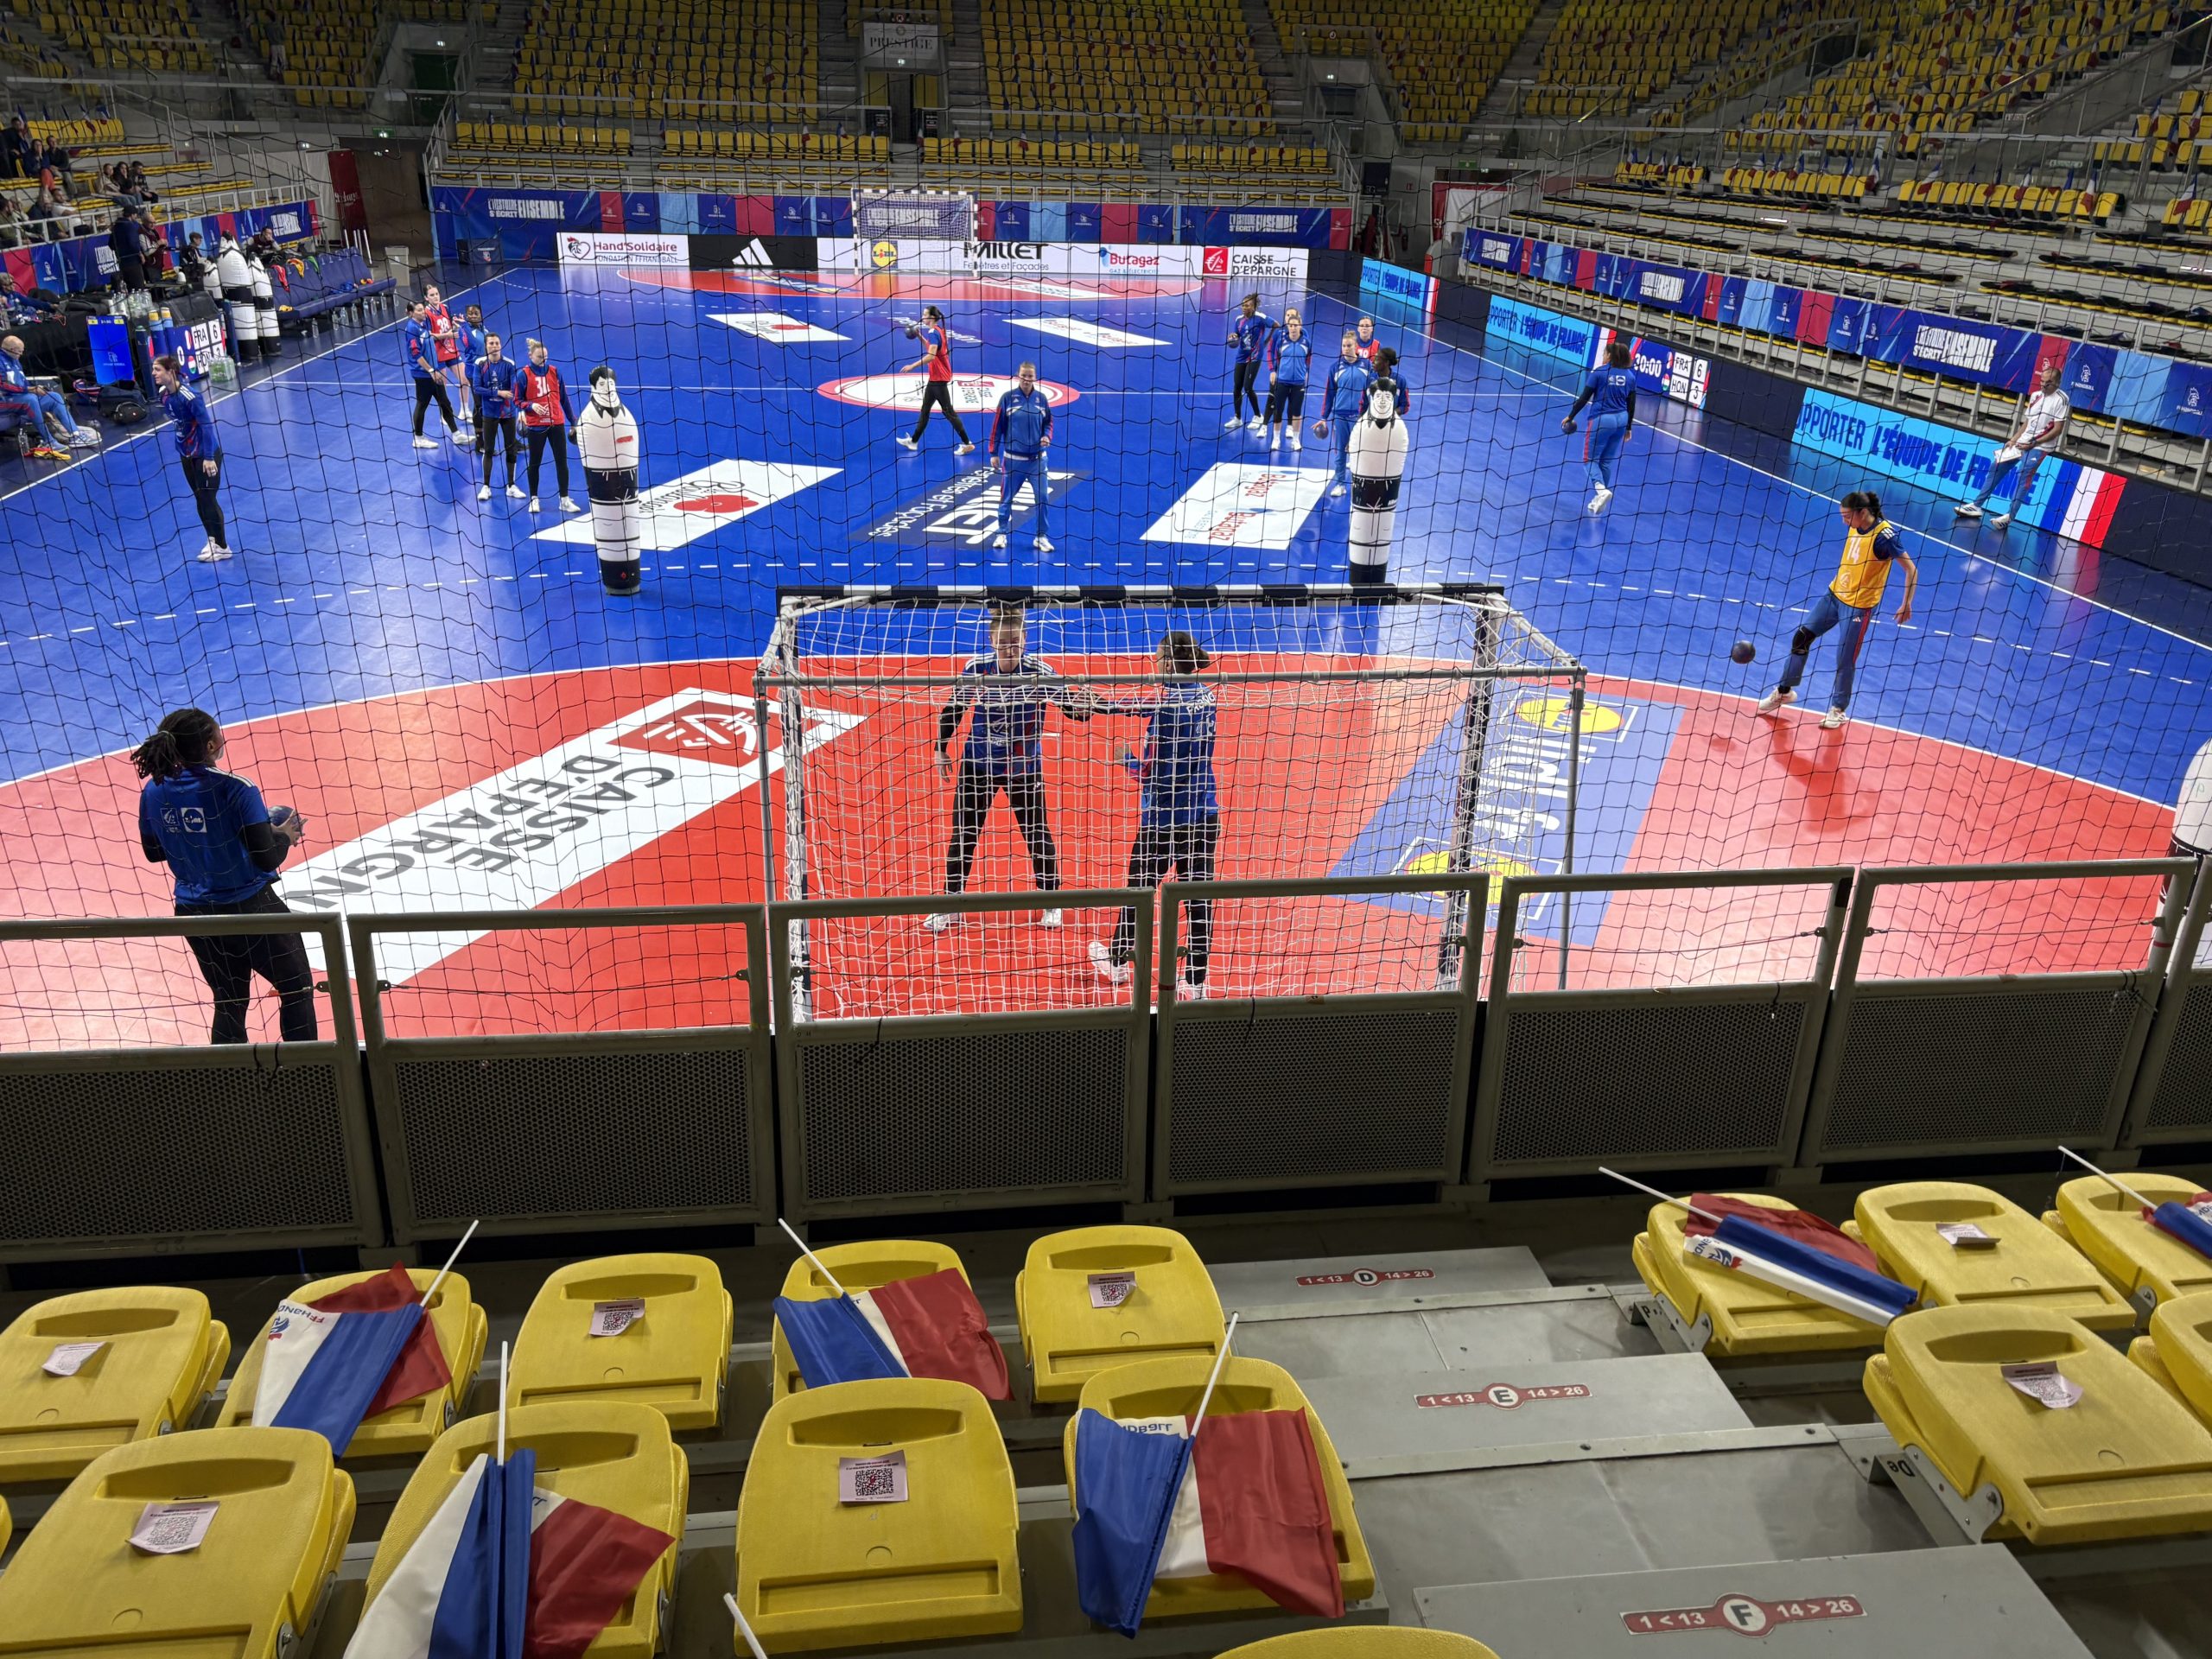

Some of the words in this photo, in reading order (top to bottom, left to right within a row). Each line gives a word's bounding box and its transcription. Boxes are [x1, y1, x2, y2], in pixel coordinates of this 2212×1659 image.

[870, 36, 933, 50] PRESTIGE
[518, 200, 565, 219] ENSEMBLE
[594, 241, 677, 252] Hand'Solidaire
[1001, 261, 1010, 270] et
[1012, 262, 1050, 272] Façades
[1109, 252, 1160, 268] Butagaz
[1232, 254, 1274, 264] CAISSE
[213, 324, 219, 339] 6
[436, 317, 449, 334] 38
[193, 327, 208, 345] FRA
[1547, 323, 1560, 346] DE
[1940, 330, 1998, 373] ENSEMBLE
[1634, 353, 1662, 378] 30:00
[1675, 357, 1689, 372] FRA
[1697, 363, 1702, 378] 6
[1671, 378, 1687, 394] HON
[1693, 385, 1699, 400] 3
[1872, 423, 1943, 475] L'ÉQUIPE
[1939, 446, 1968, 483] DE
[1963, 453, 2040, 505] FRNCE
[1847, 536, 1861, 564] 14
[444, 765, 676, 874] CAISSE
[1327, 1274, 1343, 1283] 13
[1358, 1272, 1374, 1283] D
[1414, 1269, 1430, 1278] 26
[1427, 1395, 1436, 1405] 1
[1455, 1393, 1475, 1404] 13
[1492, 1389, 1514, 1403] E
[1527, 1388, 1547, 1398] 14
[1565, 1386, 1583, 1396] 26
[1639, 1615, 1653, 1628] 1
[1678, 1611, 1706, 1625] 13
[1730, 1603, 1753, 1626] F
[1777, 1604, 1804, 1618] 14
[1826, 1599, 1855, 1614] 26
